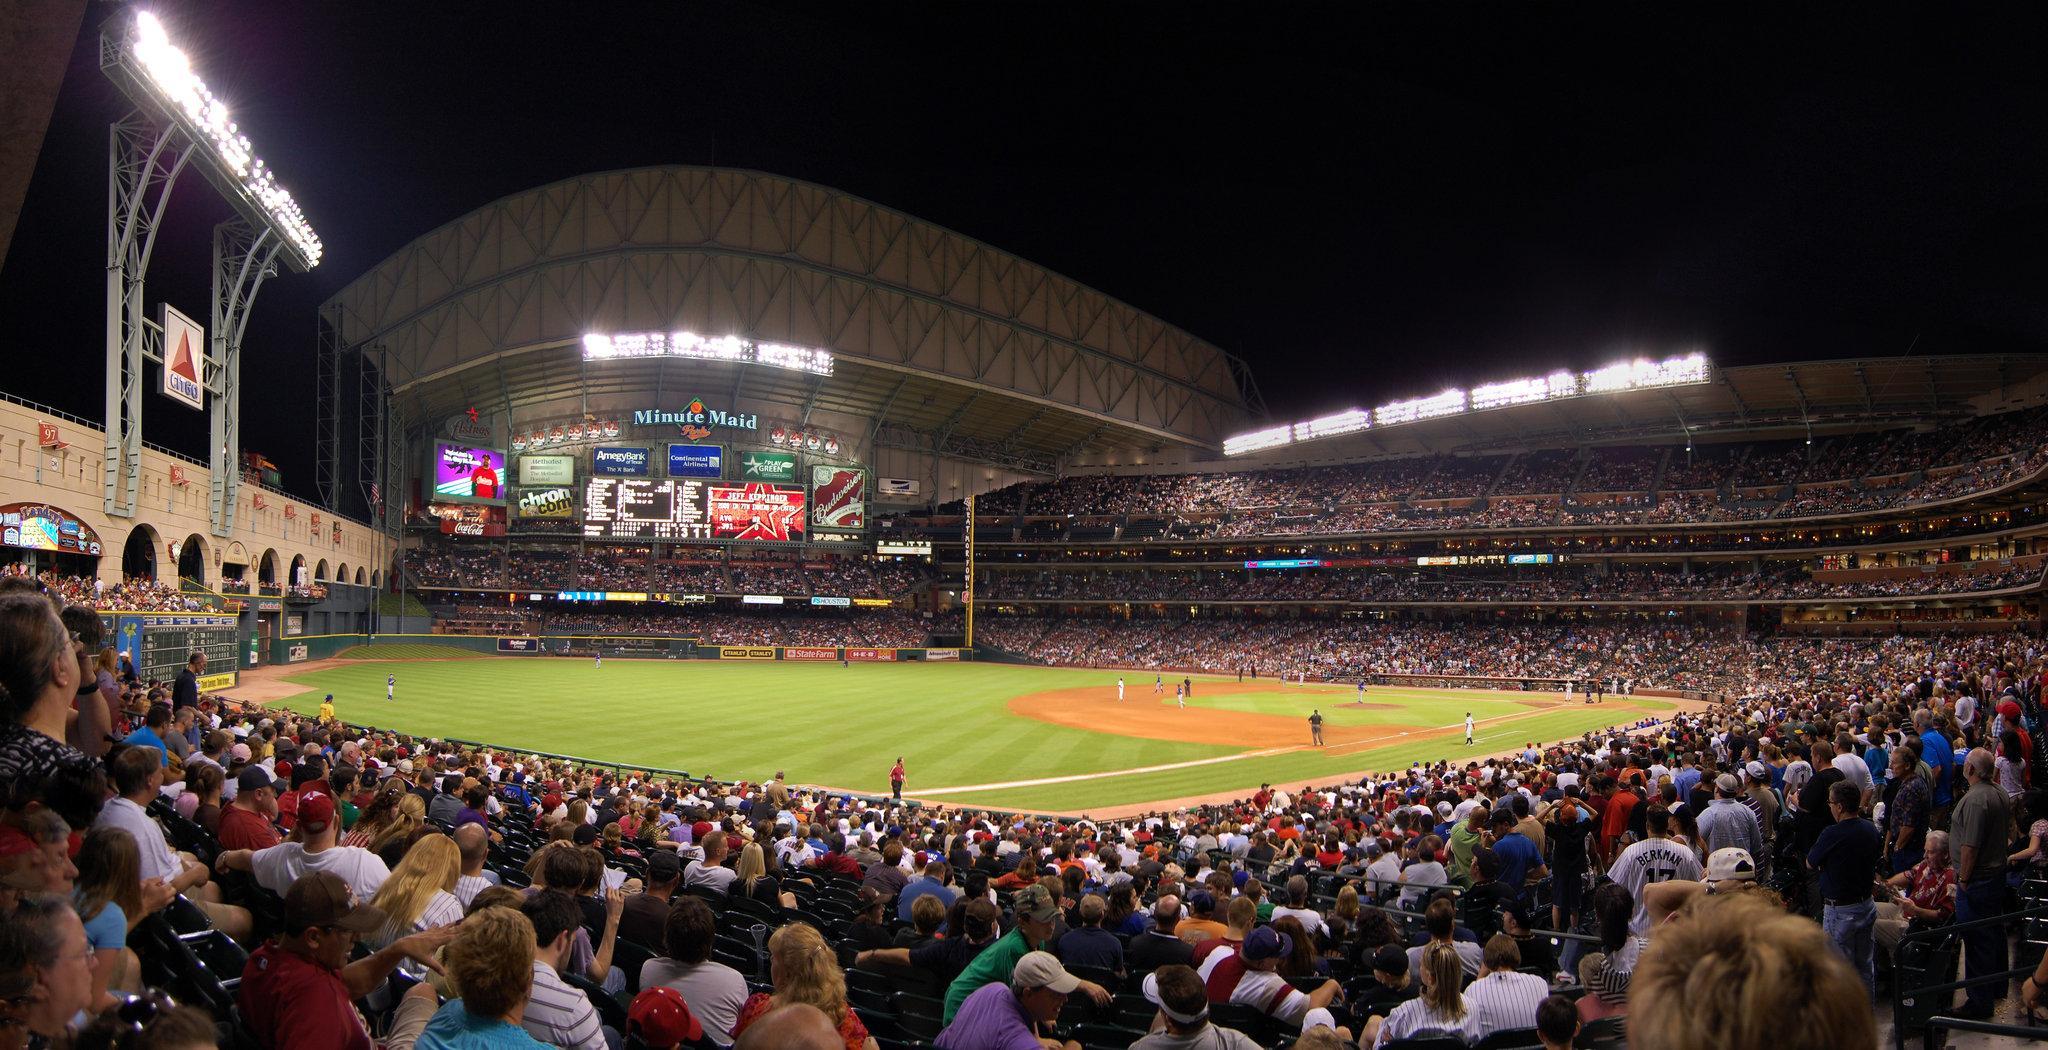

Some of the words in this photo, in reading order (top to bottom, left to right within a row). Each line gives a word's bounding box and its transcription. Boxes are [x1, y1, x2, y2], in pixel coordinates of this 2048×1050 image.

[170, 373, 198, 400] CITGO
[634, 409, 704, 424] Minute
[709, 410, 757, 429] Maid
[45, 429, 56, 440] 97
[680, 424, 711, 440] Park
[670, 454, 708, 462] Continental
[174, 469, 183, 478] 98
[758, 465, 783, 473] GREEN
[519, 488, 571, 511] chron
[728, 492, 745, 500] JEFF
[749, 493, 788, 502] KEPPINGER
[813, 470, 863, 523] Budweiser
[539, 497, 573, 515] com
[681, 528, 688, 538] 3
[693, 528, 699, 538] 1
[704, 528, 711, 538] 1
[1637, 849, 1682, 867] BERKMAN
